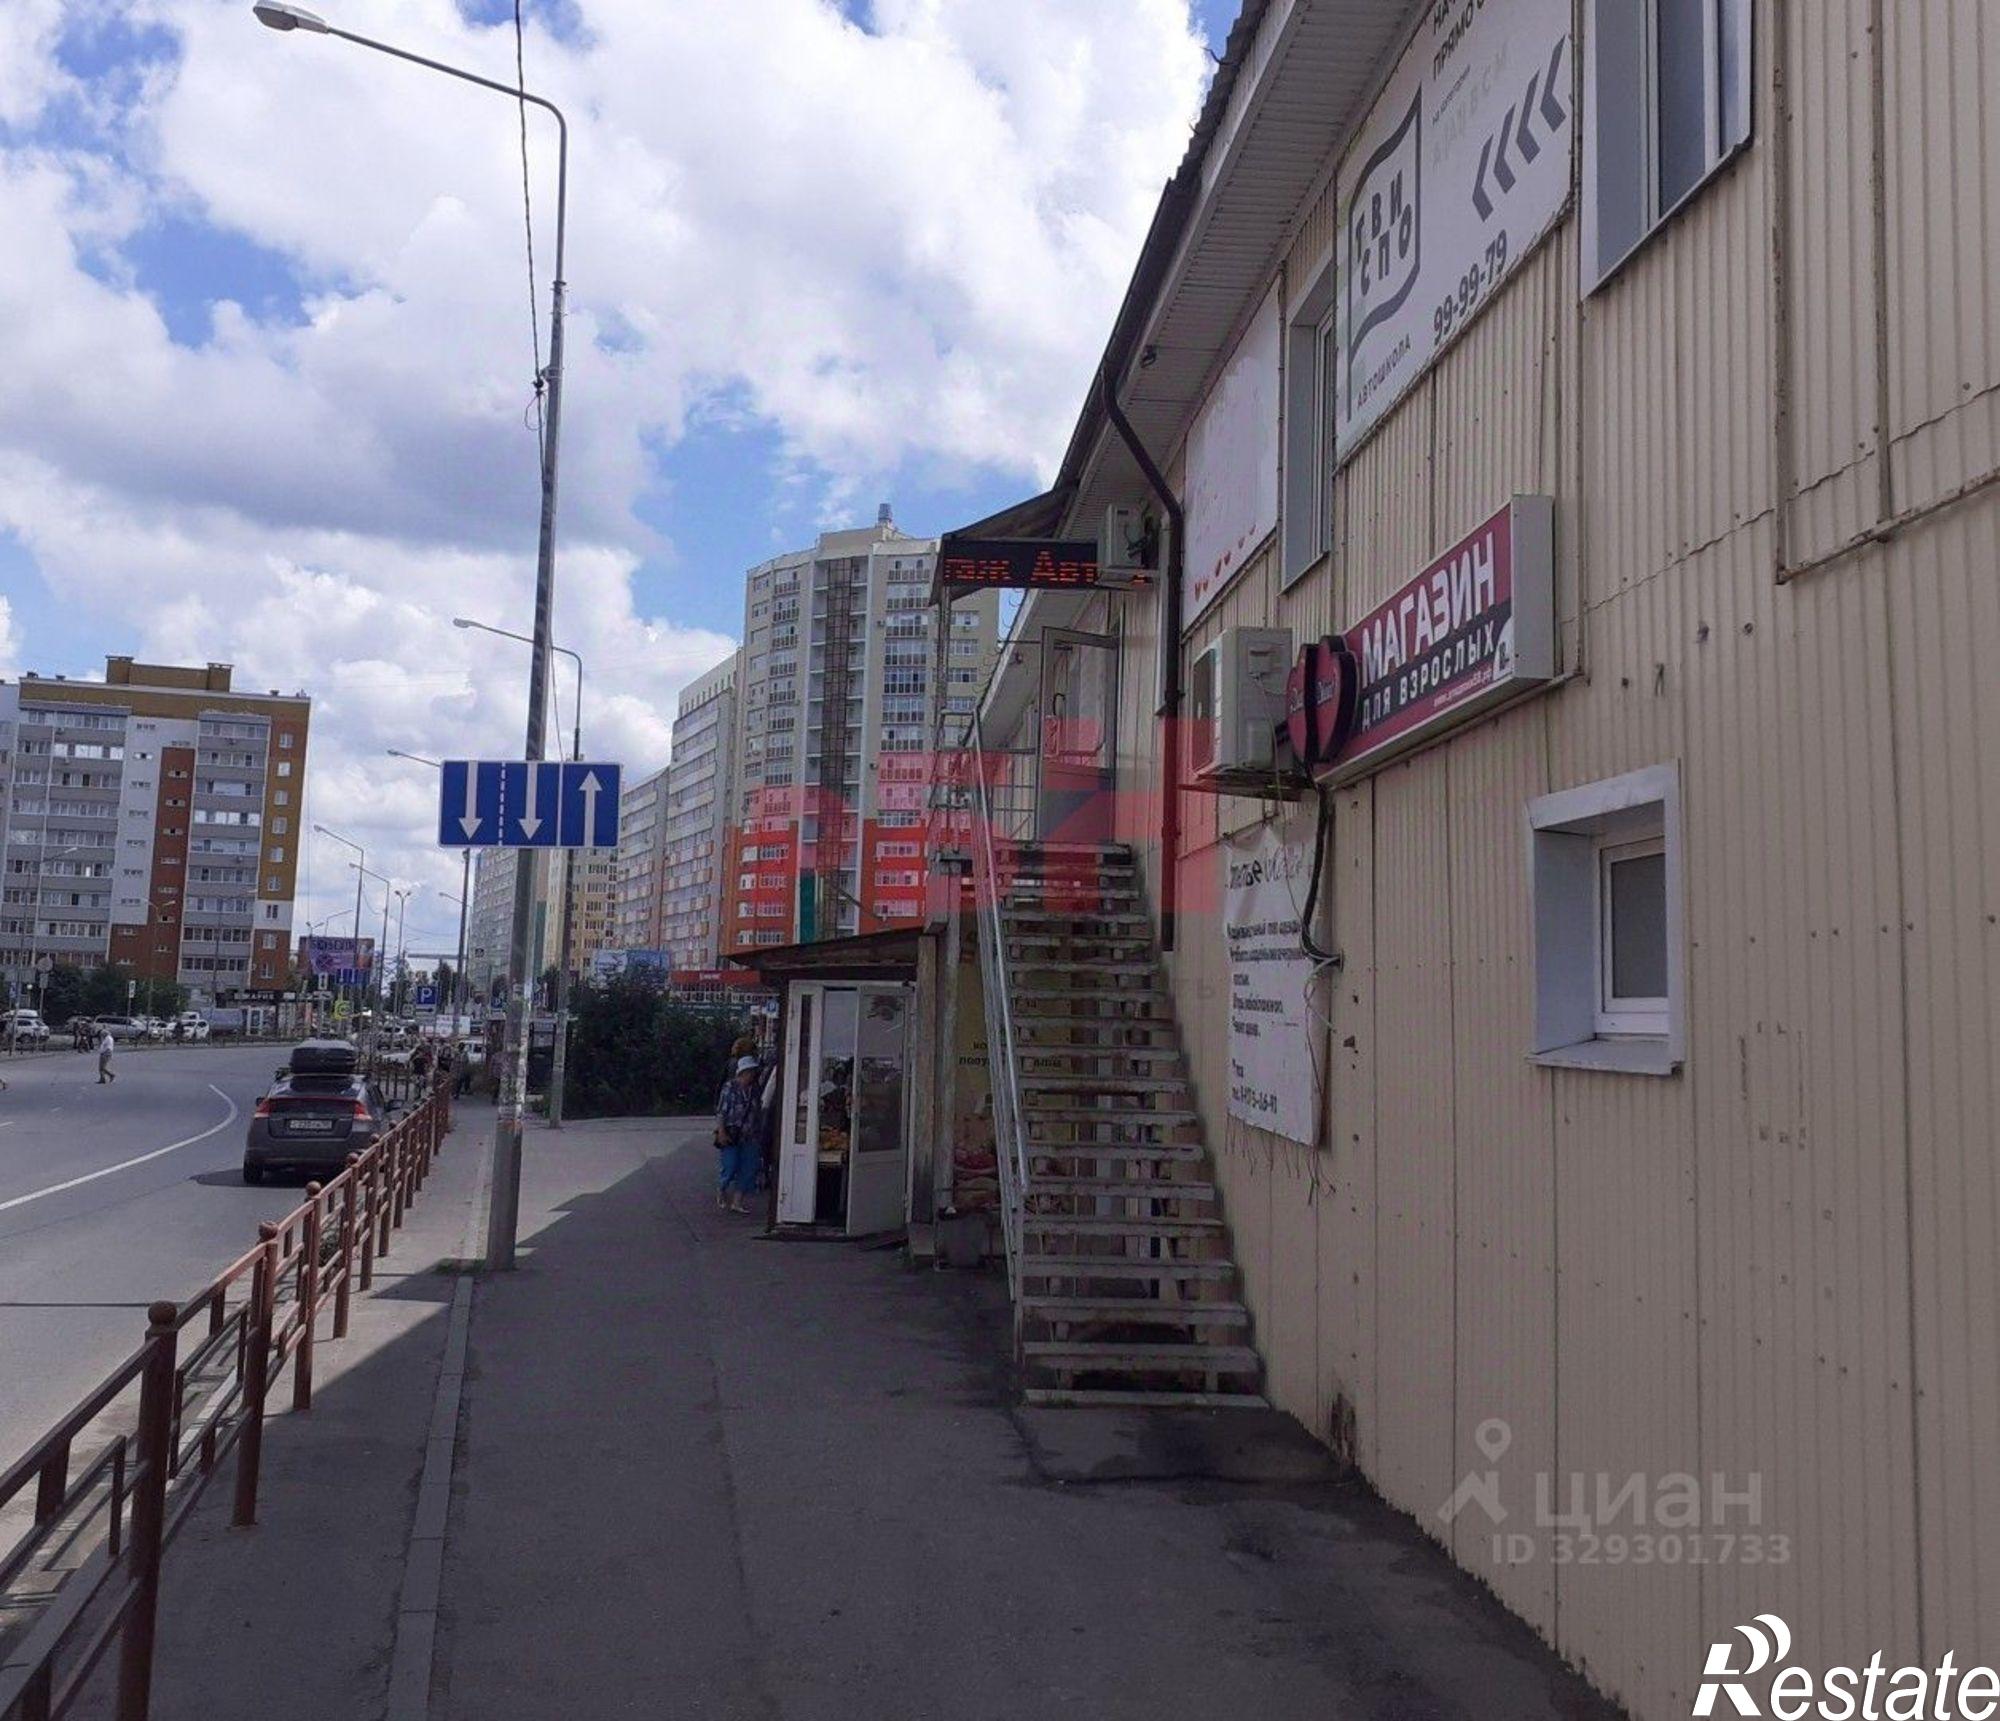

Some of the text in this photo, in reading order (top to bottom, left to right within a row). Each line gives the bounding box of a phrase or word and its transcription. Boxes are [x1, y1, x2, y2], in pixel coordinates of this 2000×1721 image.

[1355, 169, 1403, 264] ТВИ
[1360, 203, 1413, 297] СПО
[1433, 228, 1508, 346] 99-99-79
[1356, 333, 1412, 410] АВТОШКОЛА
[1361, 530, 1496, 690] МАГАЗИН
[1361, 685, 1392, 734] ДЛЯ
[1399, 619, 1495, 706] ВЗРОСЛЫХ
